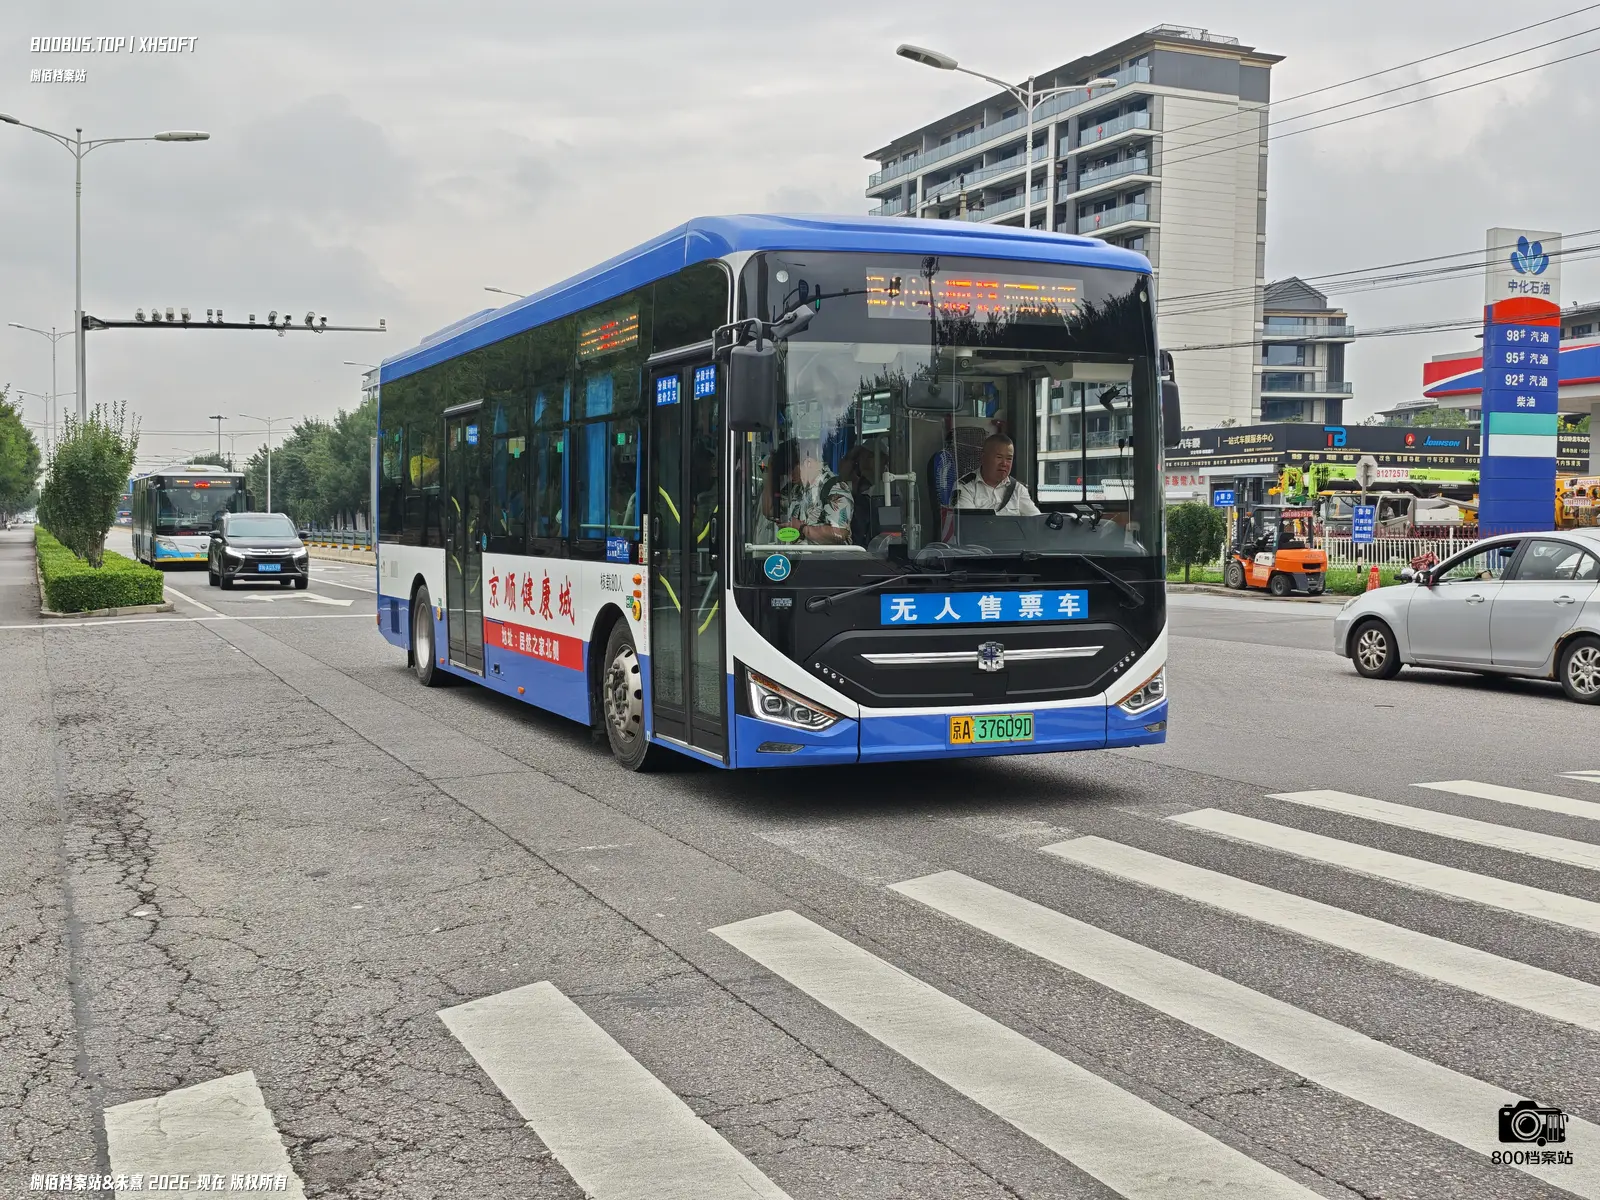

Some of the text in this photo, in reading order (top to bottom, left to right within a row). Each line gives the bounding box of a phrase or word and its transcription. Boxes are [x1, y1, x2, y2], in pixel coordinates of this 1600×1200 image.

[1507, 279, 1550, 295] 中化石油
[1506, 329, 1549, 343] 98# 汽油
[1505, 351, 1549, 365] 95# 汽油
[1505, 374, 1548, 387] 92# 汽油
[1516, 396, 1536, 408] 柴油
[1172, 438, 1201, 449] 汽车膜
[488, 567, 575, 626] 京顺健康城
[890, 592, 1081, 622] 无人售票车
[978, 717, 1032, 739] 37609D
